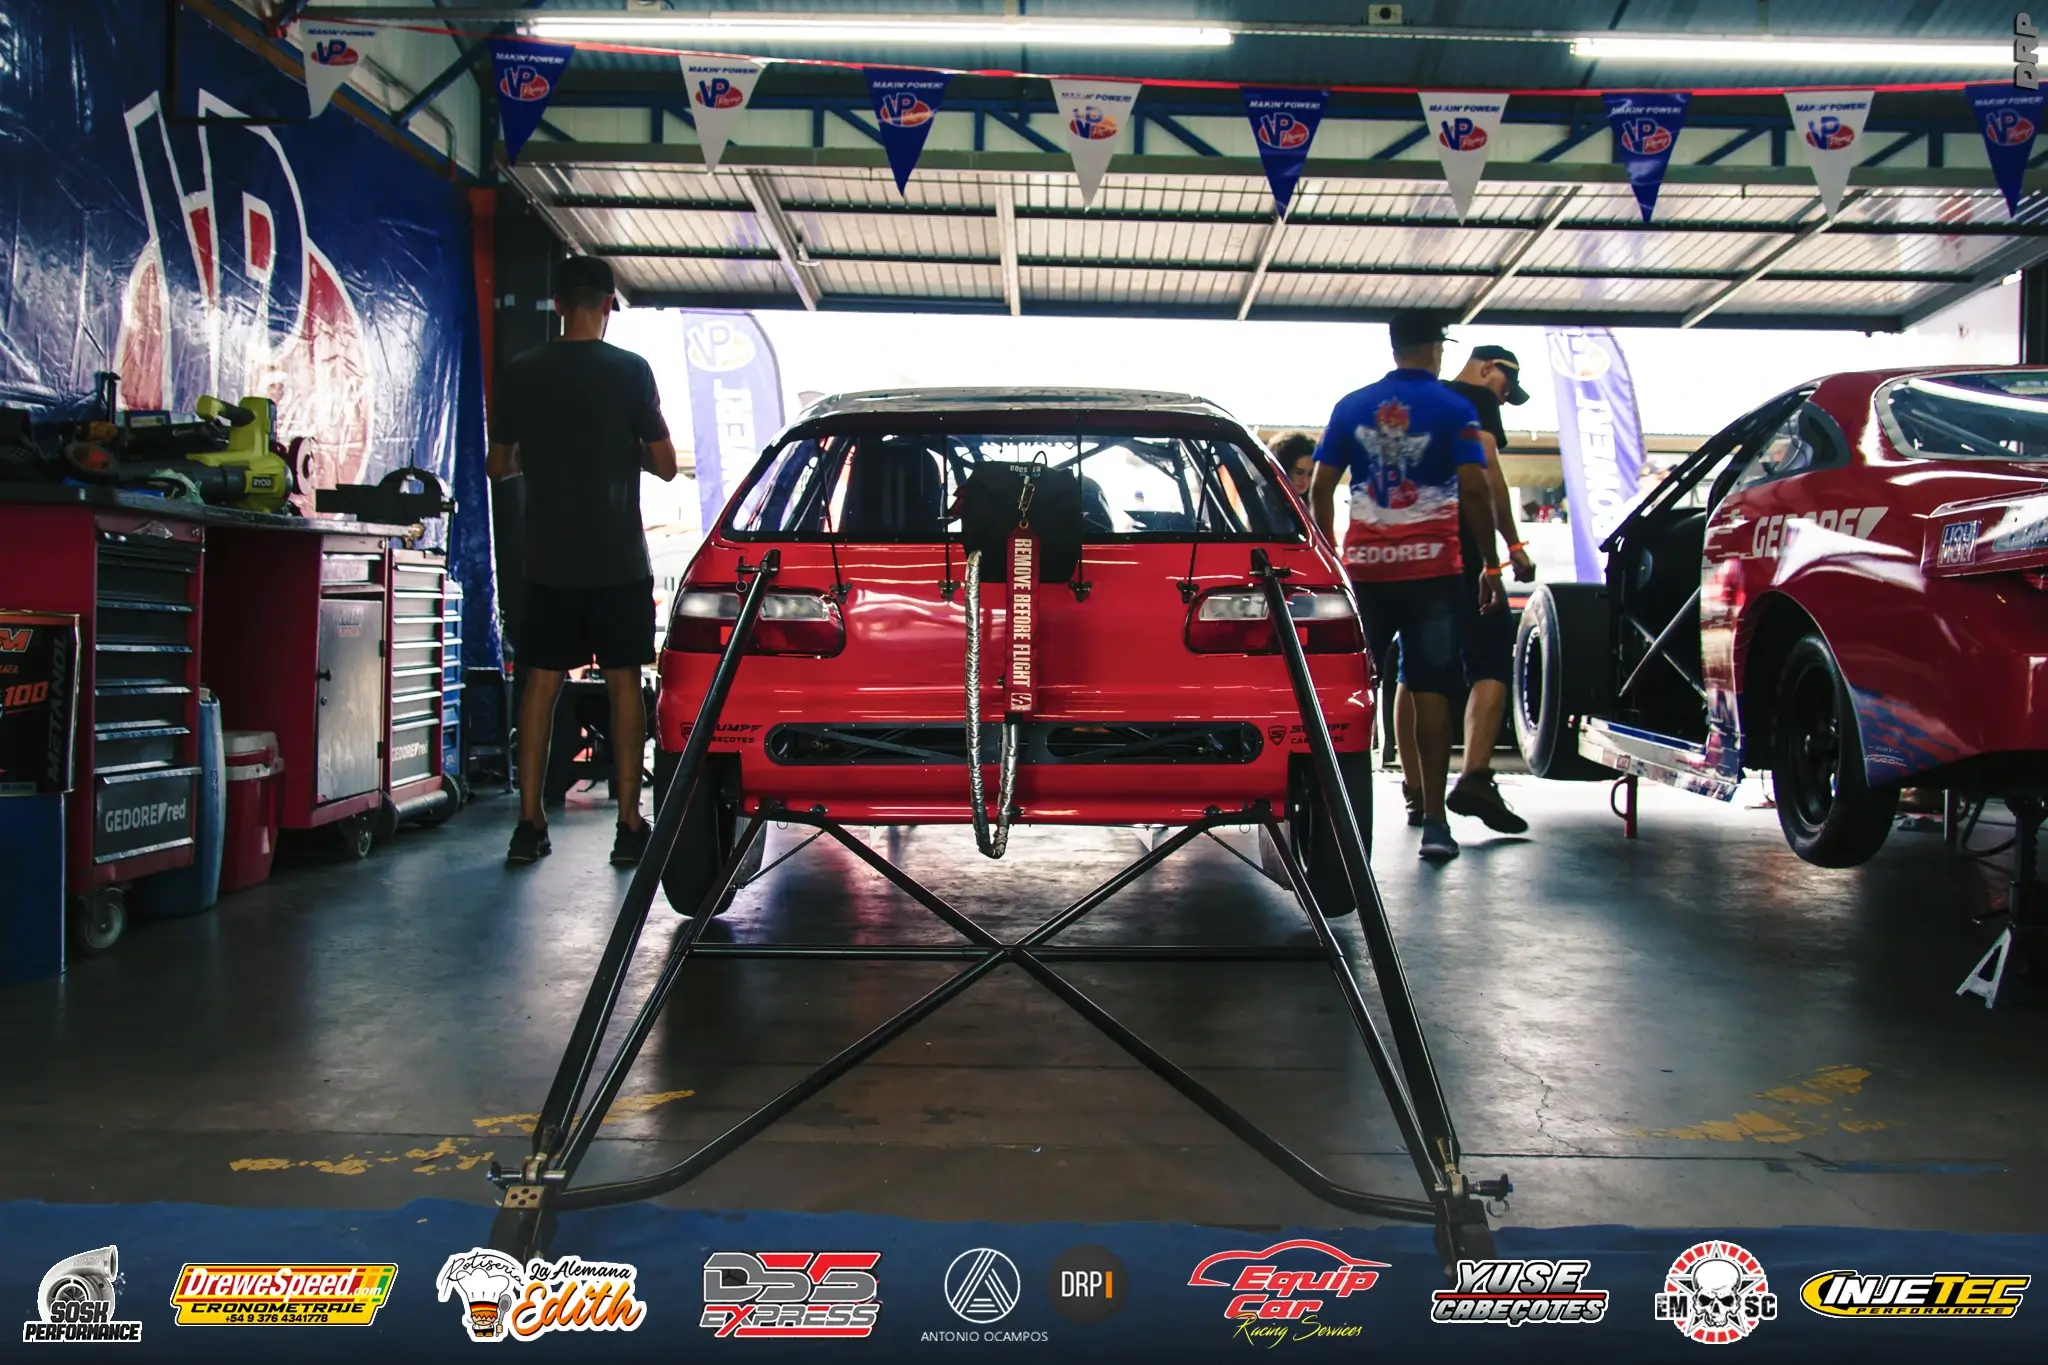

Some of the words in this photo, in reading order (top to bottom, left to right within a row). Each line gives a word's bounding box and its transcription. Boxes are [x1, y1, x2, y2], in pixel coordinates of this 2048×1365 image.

[316, 39, 347, 65] VP
[496, 53, 528, 61] MAKIN'
[529, 55, 565, 64] POWER!
[504, 65, 537, 100] VP
[688, 66, 721, 74] MAKIN'
[722, 67, 758, 76] POWER!
[872, 81, 906, 89] MAKIN'
[907, 81, 943, 90] POWER!
[699, 78, 730, 108] VP
[1095, 94, 1132, 103] POWER!
[1249, 101, 1284, 109] MAKIN'
[1284, 101, 1321, 110] POWER!
[1831, 102, 1867, 111] POWER!
[882, 92, 918, 126] VP
[1645, 107, 1681, 115] POWER!
[1260, 112, 1296, 148] VP
[1441, 118, 1473, 151] VP
[1622, 118, 1658, 154] VP
[1986, 109, 2020, 145] VP
[253, 477, 272, 488] RYOBI
[1013, 538, 1032, 590] REMOVE
[1346, 543, 1430, 563] GEDORE
[1013, 594, 1032, 640] BEFORE
[1012, 644, 1031, 687] FLIGHT
[4, 681, 48, 707] 100
[47, 636, 66, 783] METANOL
[105, 803, 159, 833] GEDORE
[167, 798, 186, 822] red
